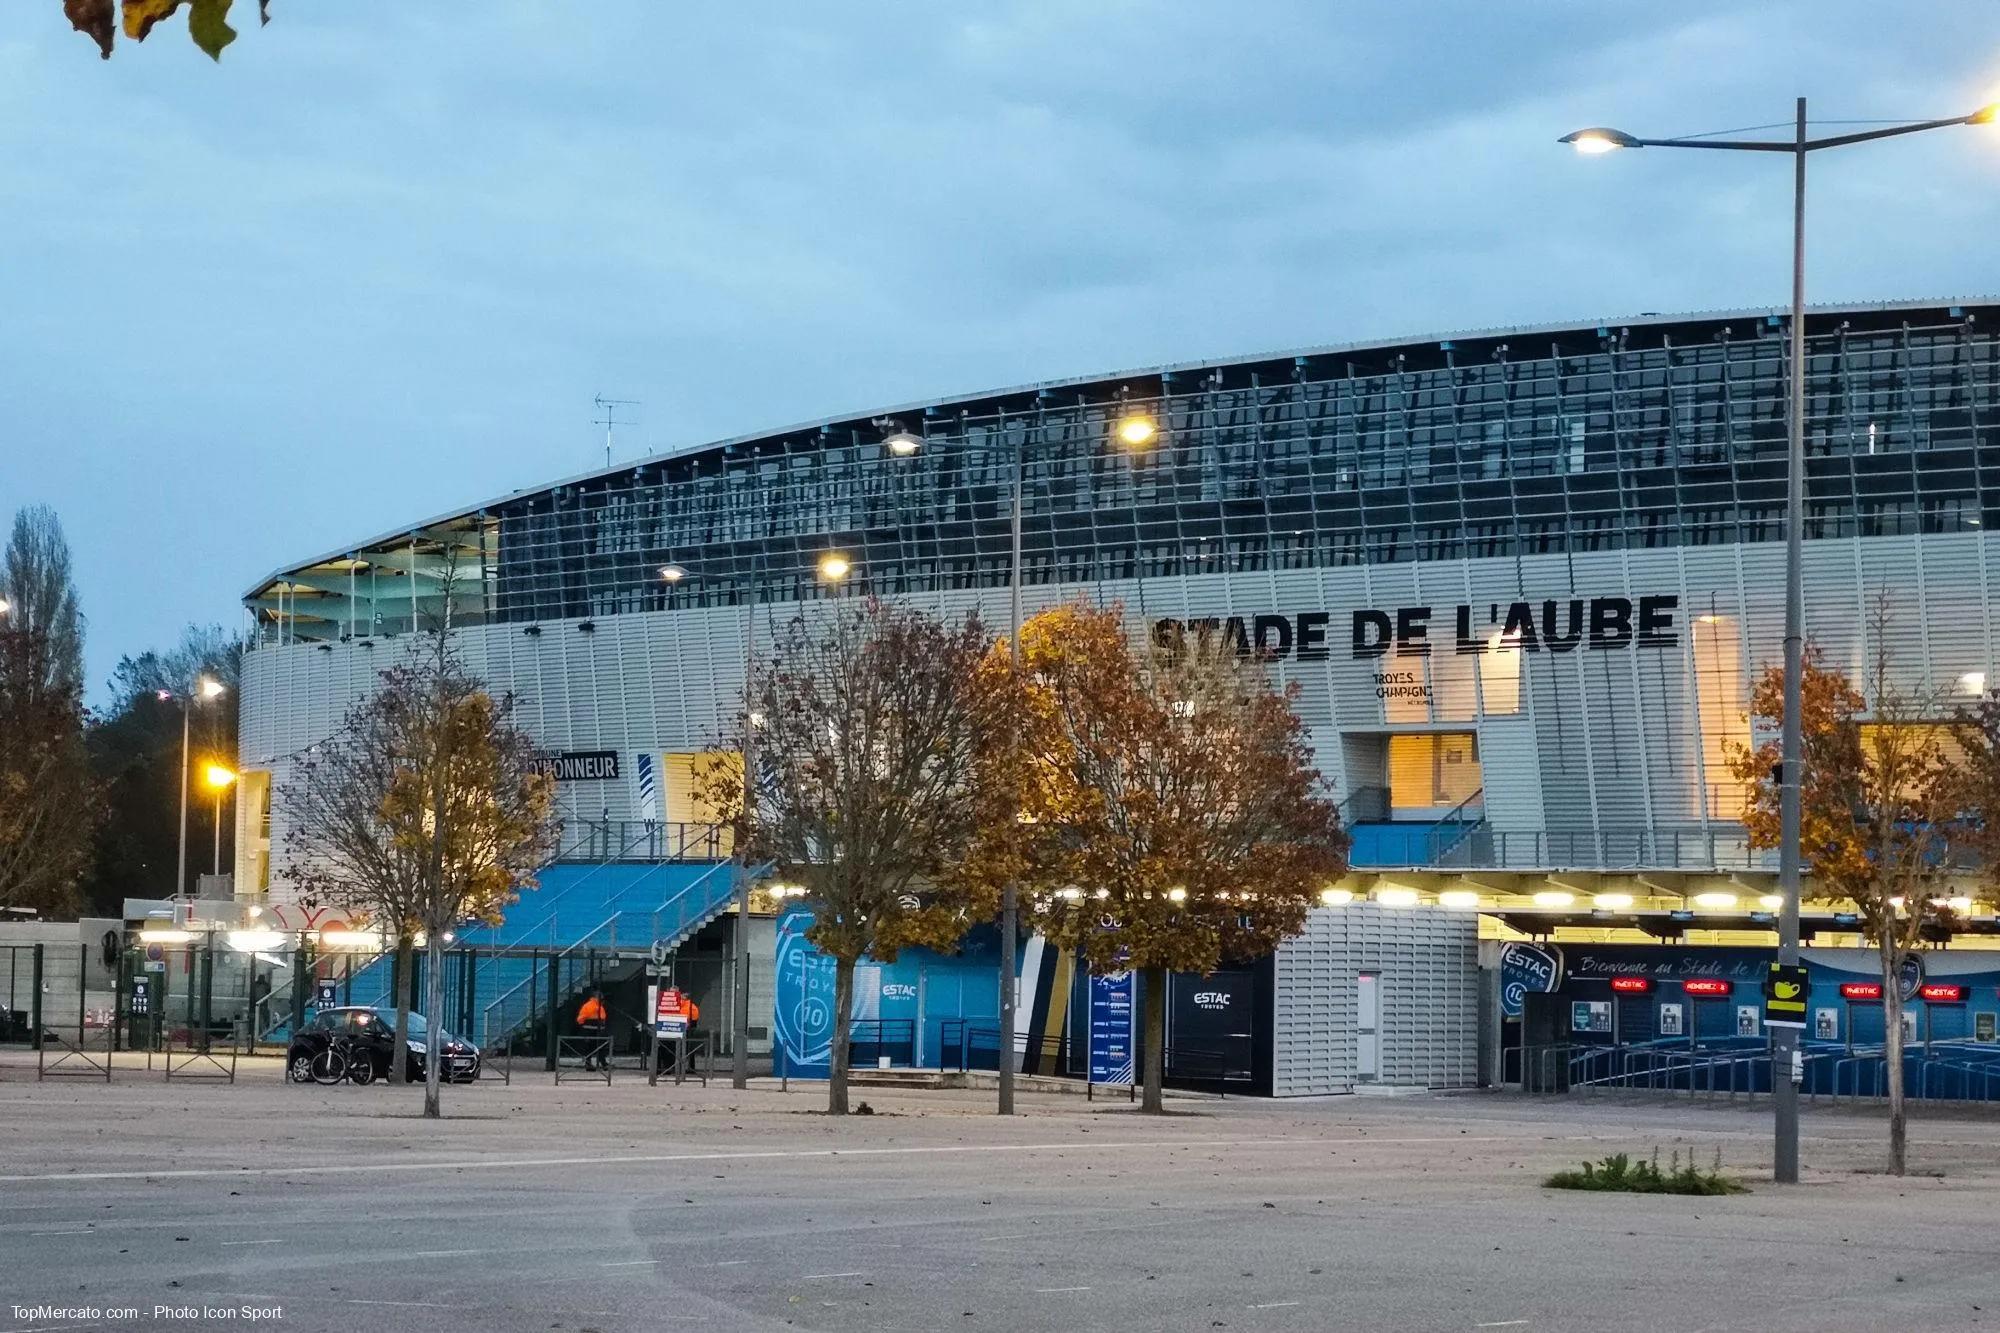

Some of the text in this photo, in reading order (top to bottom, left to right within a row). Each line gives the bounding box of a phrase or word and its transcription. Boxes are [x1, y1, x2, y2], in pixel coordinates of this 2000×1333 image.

[1152, 595, 1678, 662] STADE DE L'AUBE
[1372, 672, 1414, 684] TROYES
[1376, 685, 1433, 698] CHAMPAGNE
[1505, 951, 1551, 979] ESTAC
[1580, 956, 1647, 973] Bienvenue
[1655, 962, 1672, 974] au
[1679, 957, 1722, 975] Stade
[1731, 960, 1748, 976] de
[883, 984, 917, 997] ESTAC
[1194, 992, 1231, 1005] ESTAC
[803, 1005, 823, 1027] 10
